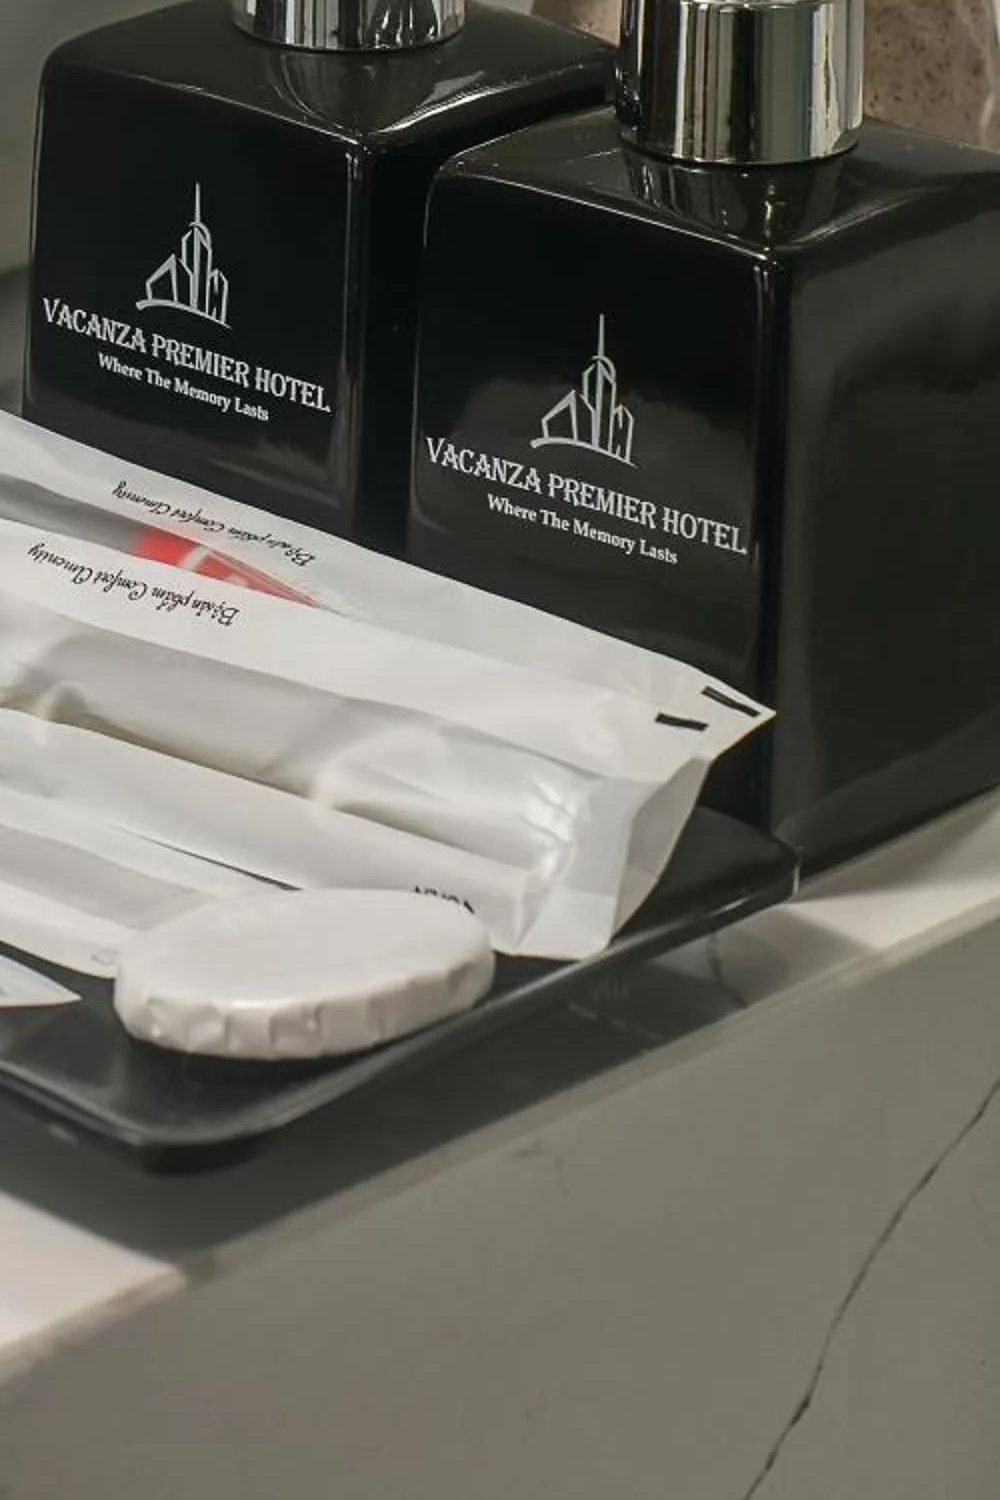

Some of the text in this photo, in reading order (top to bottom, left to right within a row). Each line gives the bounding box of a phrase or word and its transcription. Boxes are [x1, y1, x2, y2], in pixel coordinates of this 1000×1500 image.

[42, 297, 332, 413] VACANZA PREMIER HOTEL
[98, 352, 270, 422] Where The Memory Lasts
[169, 506, 226, 533] Comfort
[426, 436, 748, 556] VACANZA PREMIER HOTEL
[487, 493, 678, 564] Where The Memory Lasts
[27, 541, 94, 586] Amenity
[93, 564, 149, 601] Comfort
